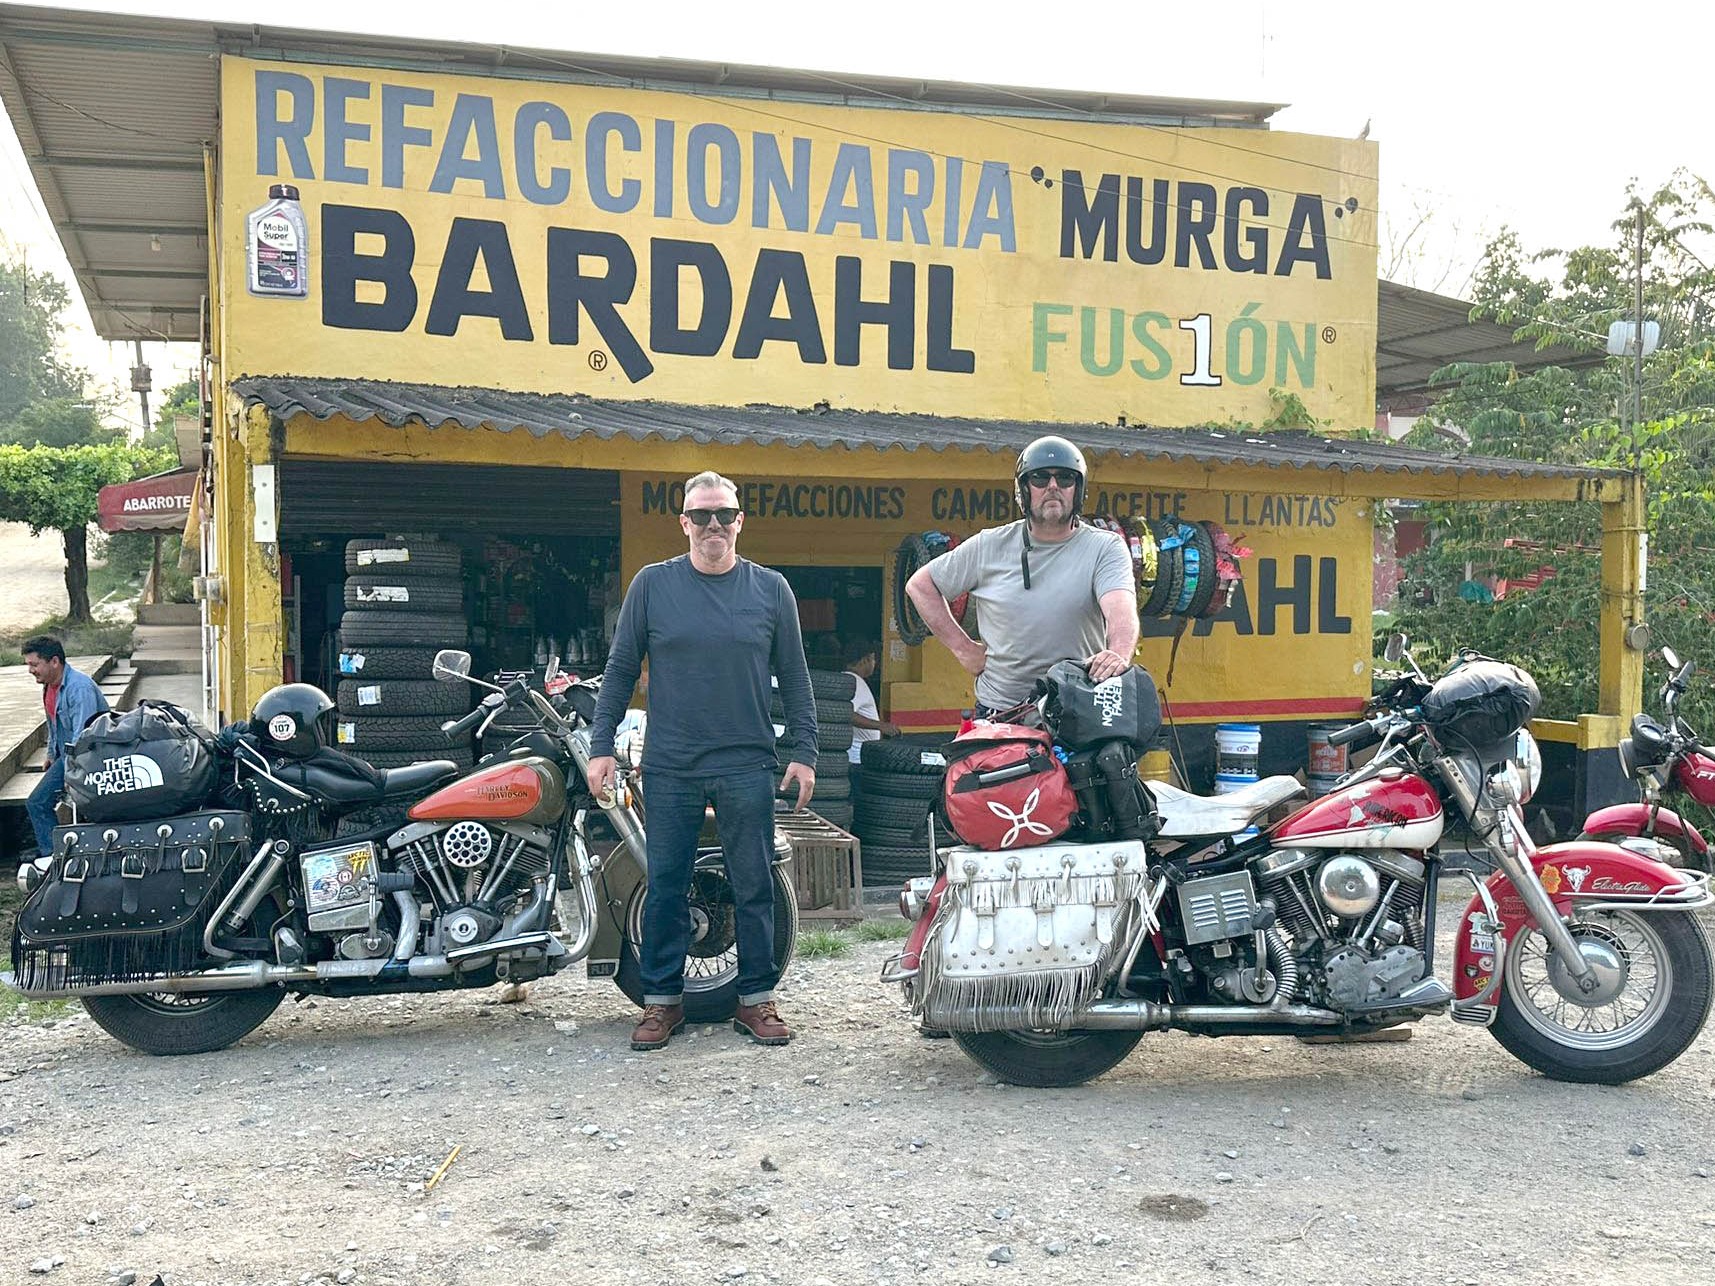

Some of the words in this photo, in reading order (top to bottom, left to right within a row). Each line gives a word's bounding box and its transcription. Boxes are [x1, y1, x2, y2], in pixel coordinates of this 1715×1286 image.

[255, 70, 1017, 253] REFACCIONARIA
[263, 223, 289, 232] Mobil
[263, 231, 289, 240] Super
[321, 203, 975, 383] BARDAHL
[123, 495, 193, 512] ABARROTE
[641, 480, 905, 519] MOEFACCIONES
[1223, 494, 1337, 529] LLANTAS
[1101, 685, 1113, 727] NORTH
[1111, 686, 1123, 717] FACE
[274, 723, 290, 733] 107
[103, 755, 131, 771] THE
[84, 767, 133, 786] NORTH
[97, 778, 135, 796] FACE
[477, 784, 510, 795] HARLEY
[488, 791, 528, 802] DAVIDSON
